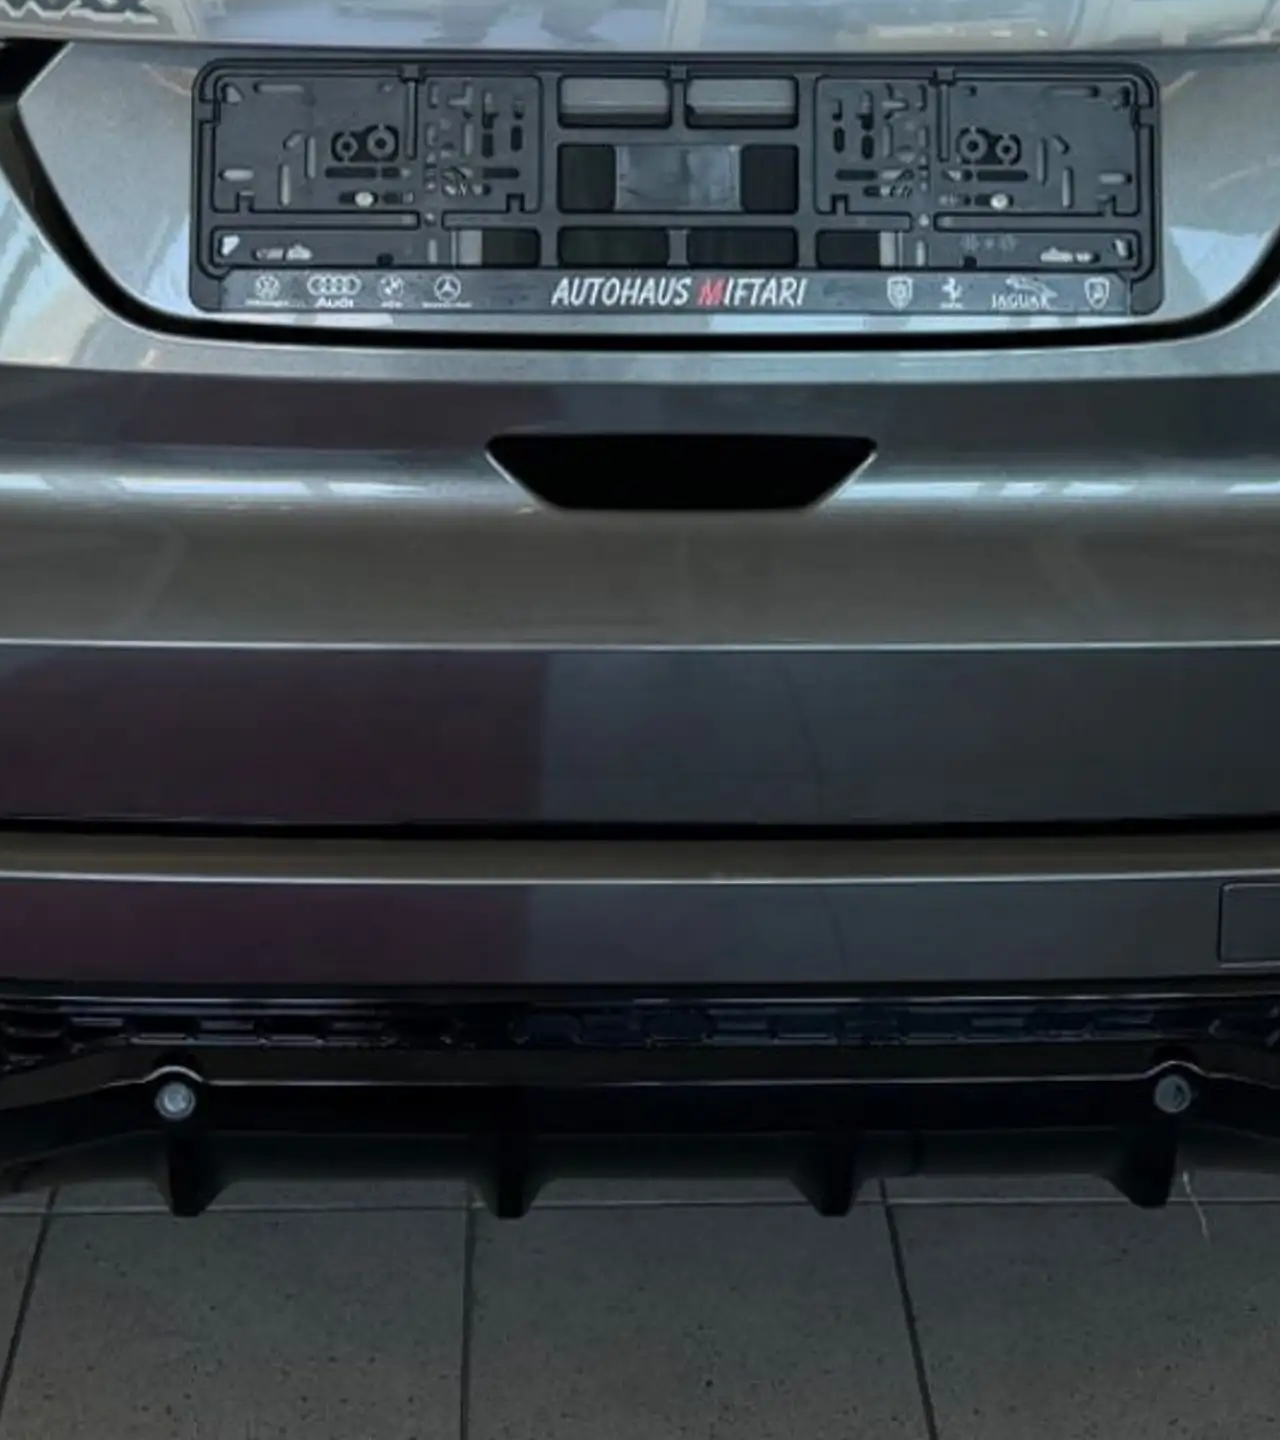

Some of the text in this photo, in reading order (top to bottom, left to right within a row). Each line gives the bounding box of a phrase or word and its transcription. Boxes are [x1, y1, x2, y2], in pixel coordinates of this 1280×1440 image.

[550, 276, 810, 307] AUTOHAUS MIFTARI
[313, 297, 355, 309] Audi
